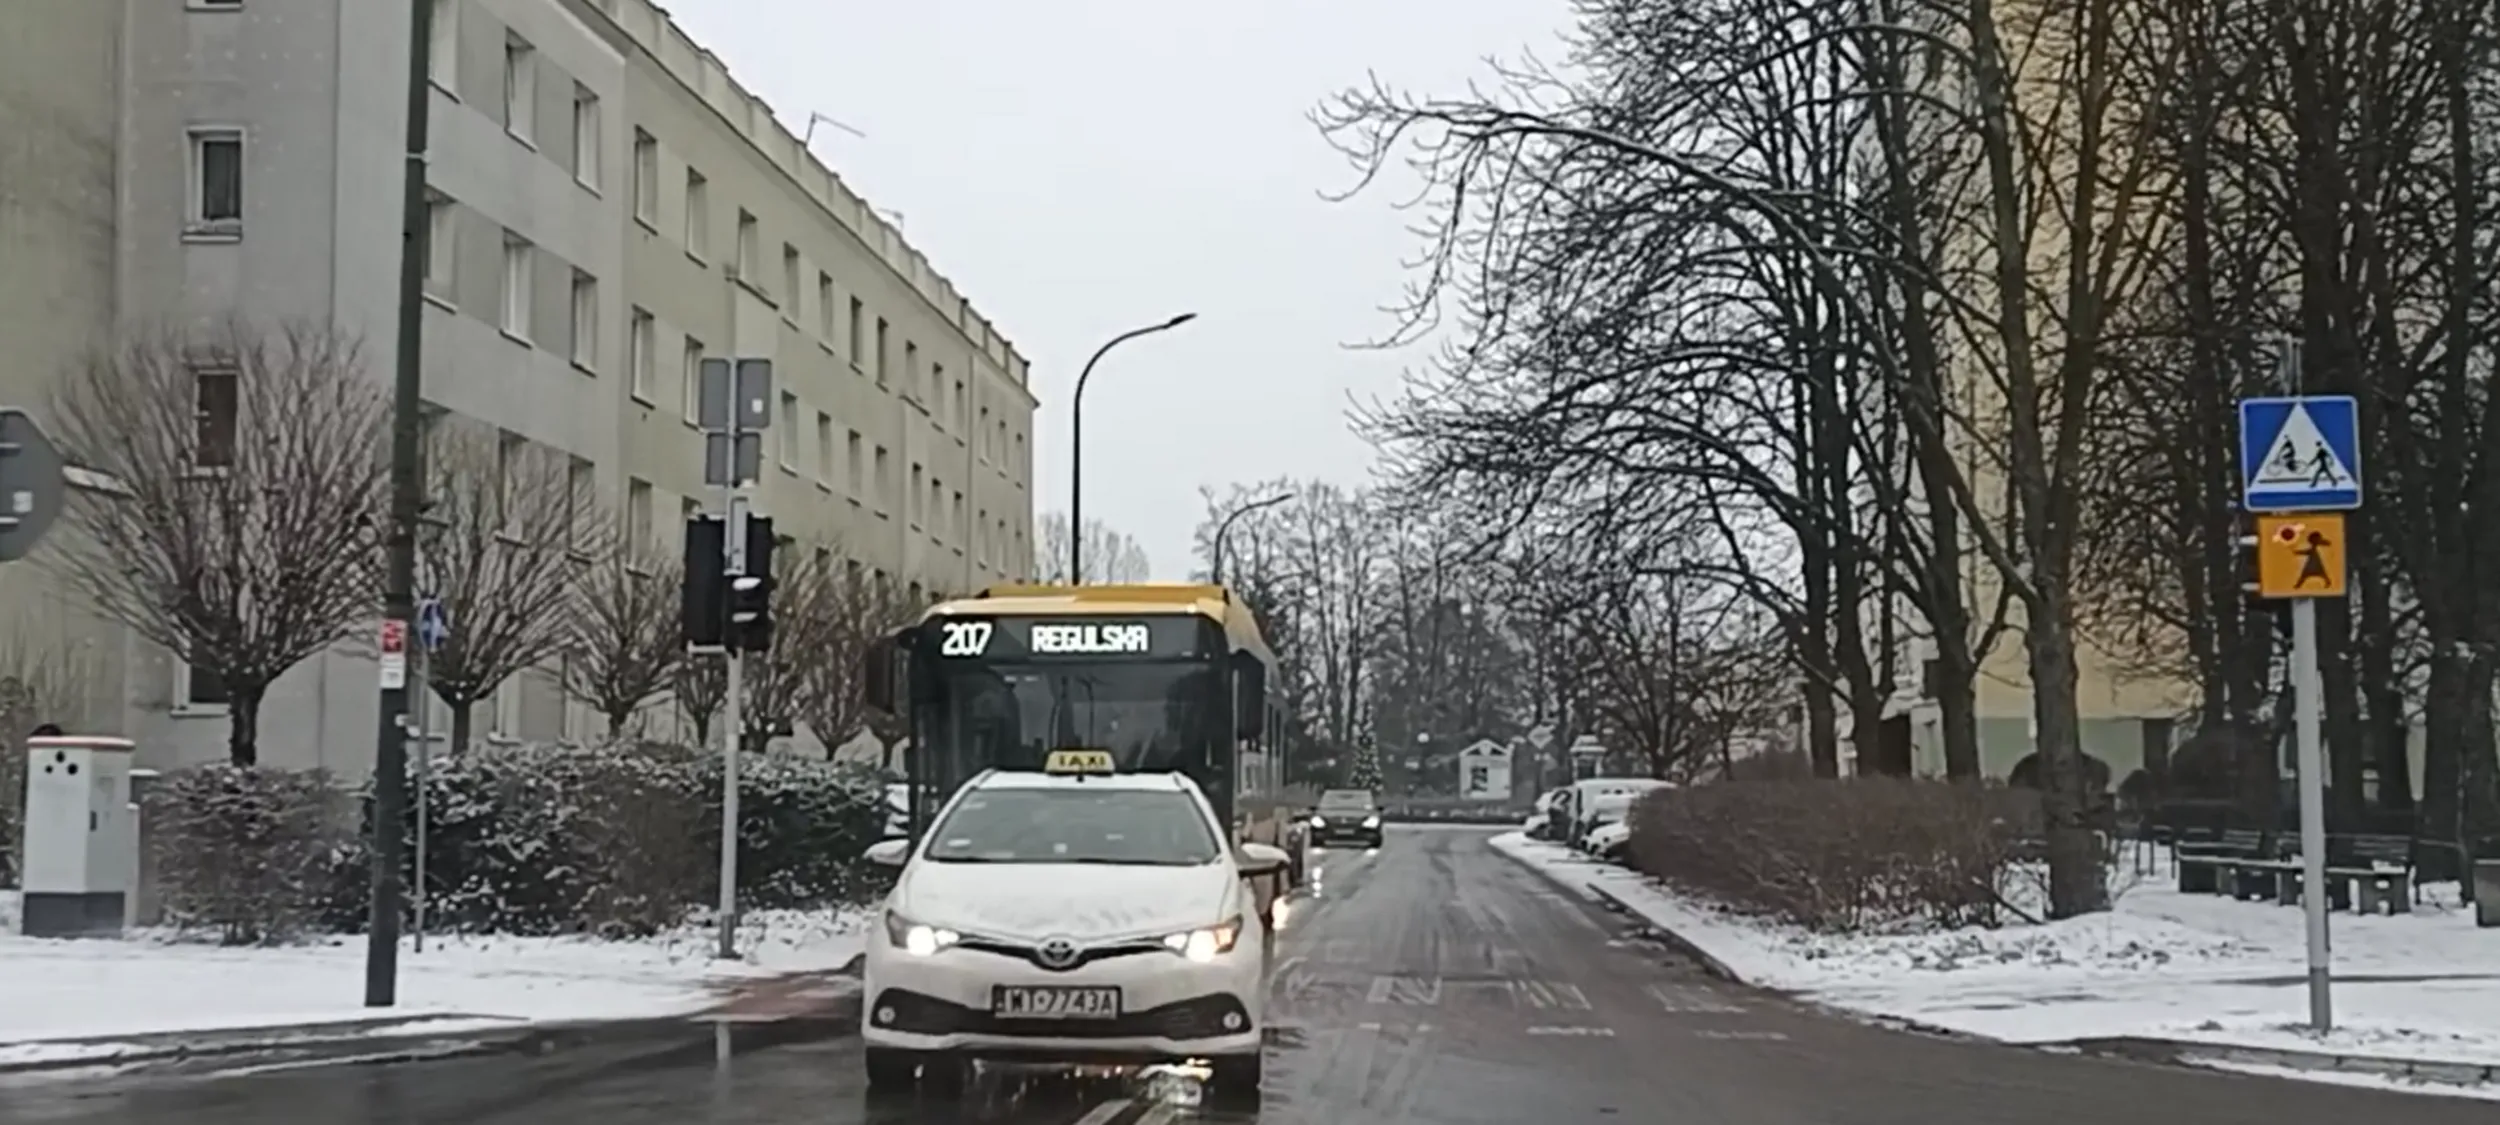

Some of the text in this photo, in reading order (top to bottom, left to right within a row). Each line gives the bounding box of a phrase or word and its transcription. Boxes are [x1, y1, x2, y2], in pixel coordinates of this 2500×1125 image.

[942, 622, 1149, 656] 207 REGULSKA
[1058, 754, 1107, 767] TAXI
